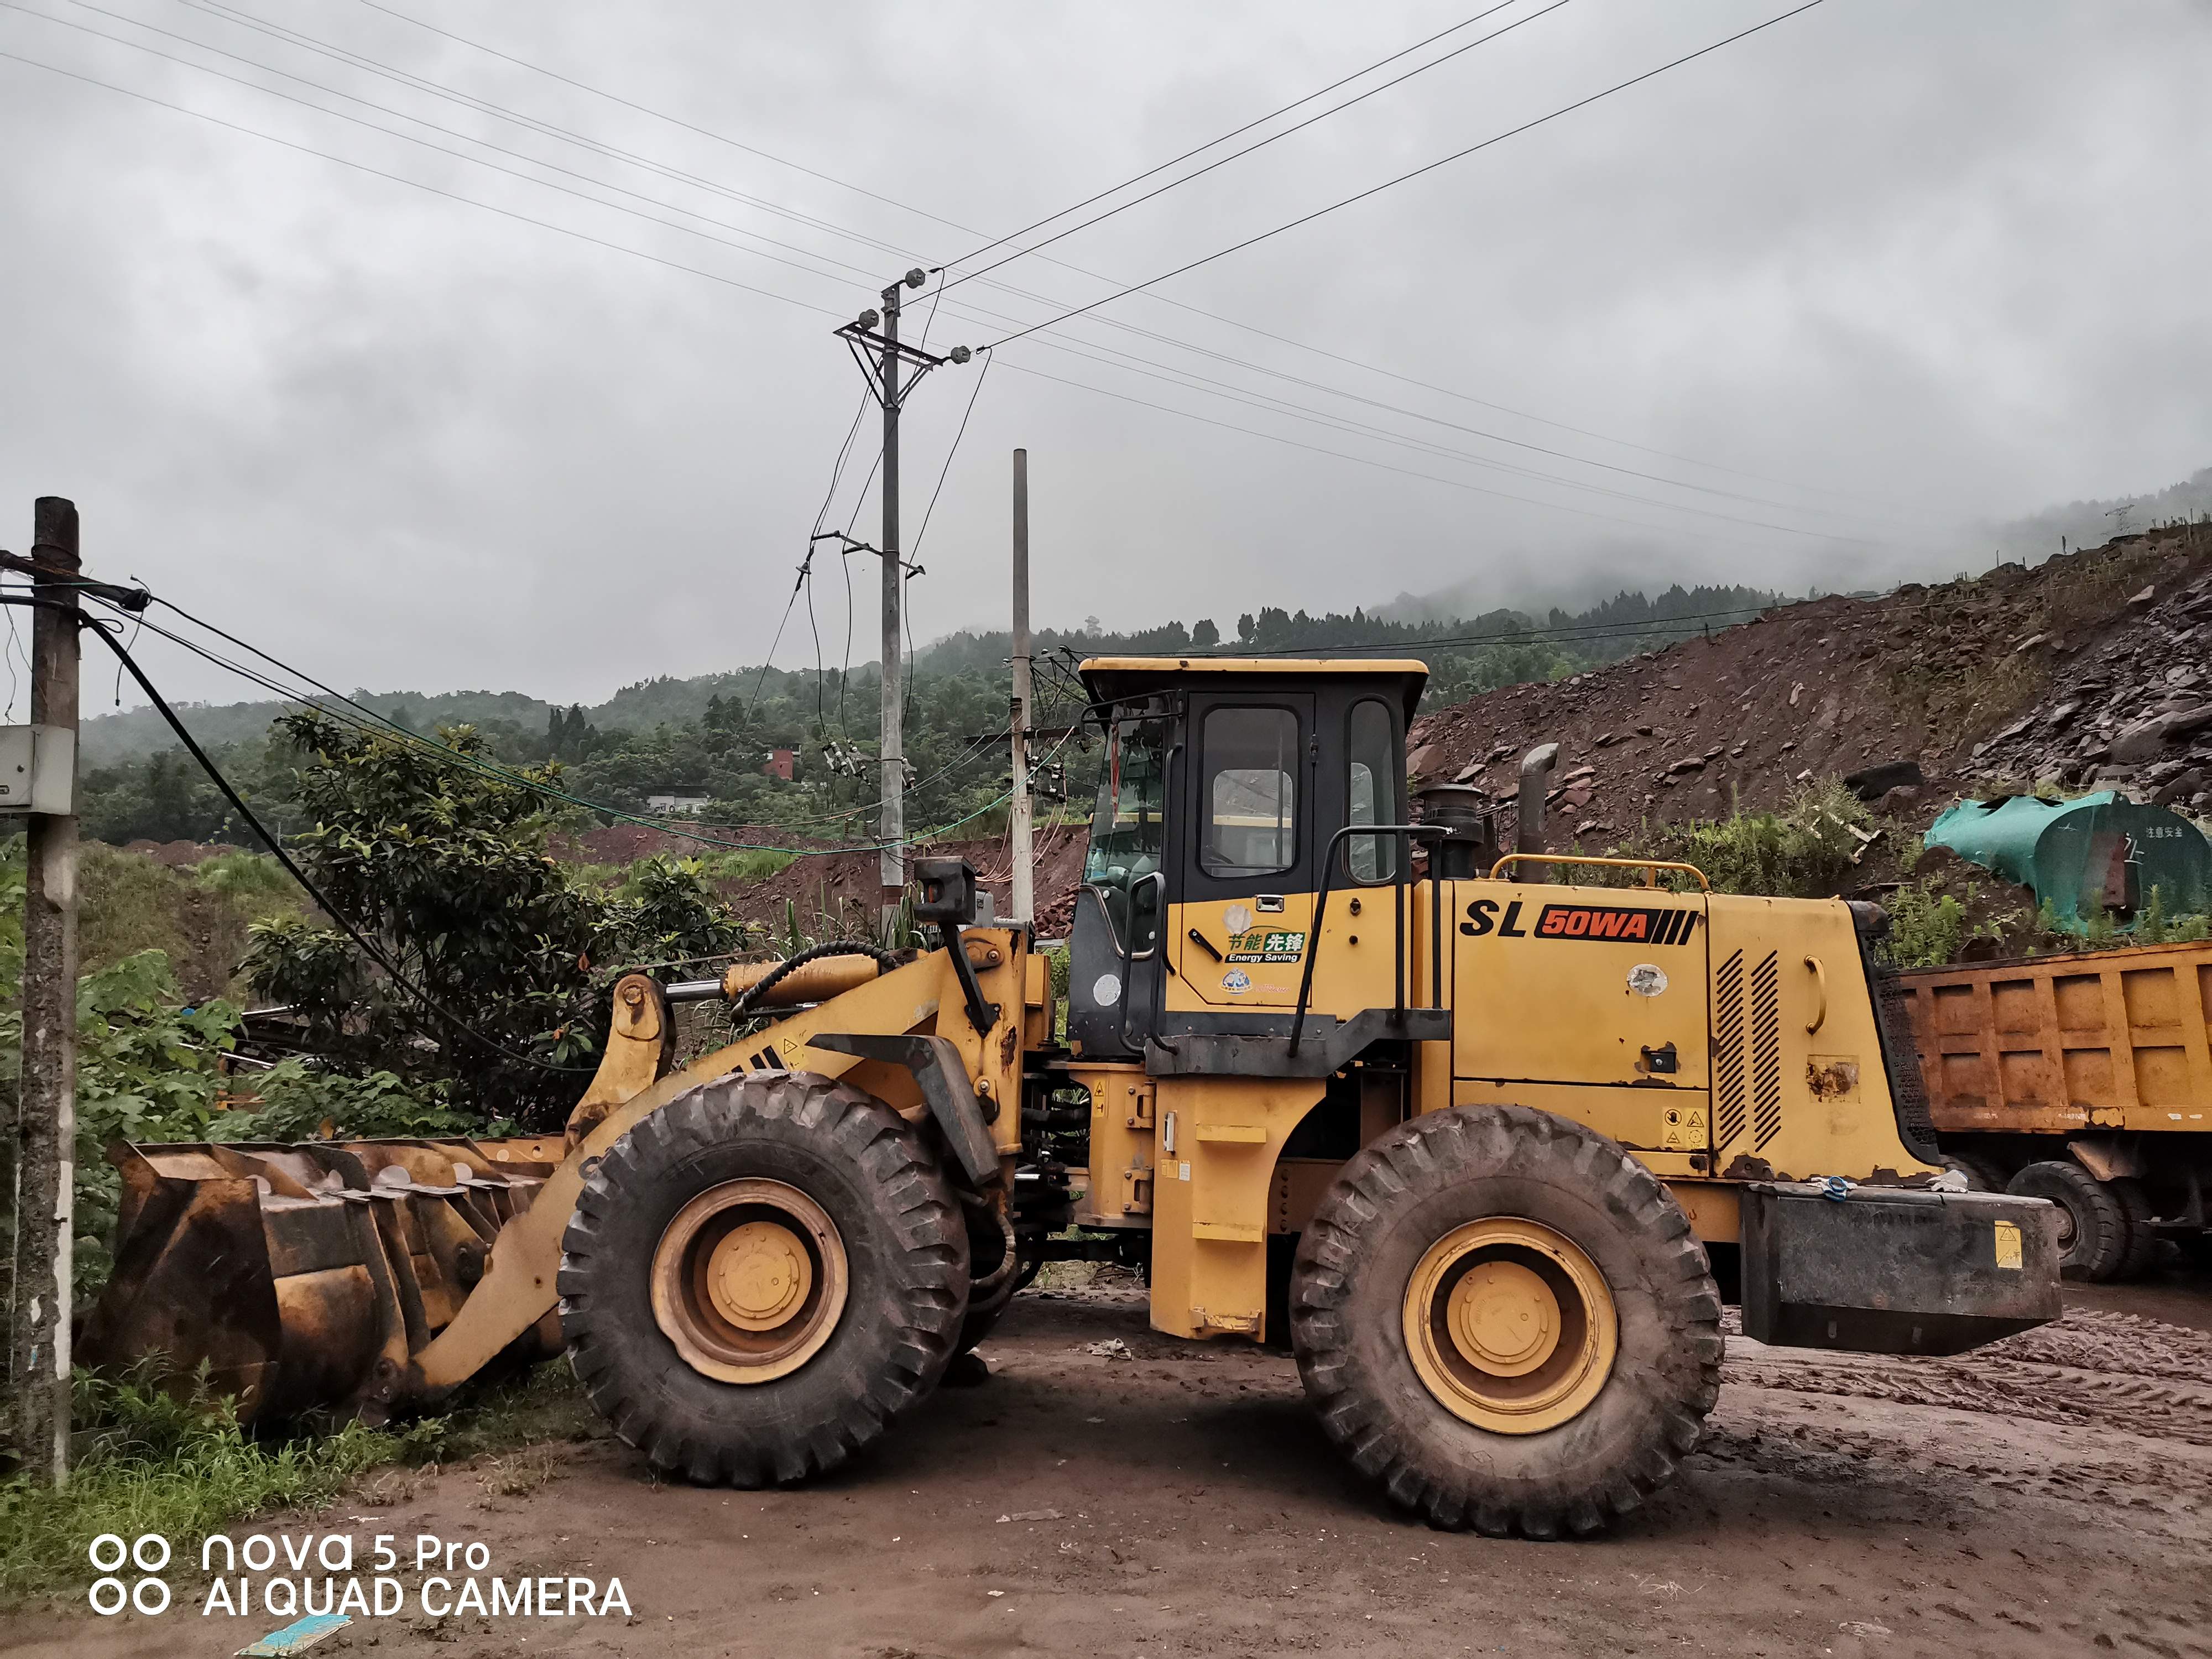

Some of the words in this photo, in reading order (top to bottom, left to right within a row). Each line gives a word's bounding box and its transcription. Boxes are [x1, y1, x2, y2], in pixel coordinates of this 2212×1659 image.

[2146, 826, 2183, 838] 注意安全
[1459, 899, 1526, 938] SL
[1541, 909, 1648, 938] 50WA
[1228, 933, 1303, 952] 节能先锋
[1229, 954, 1263, 963] Energy
[1264, 954, 1298, 963] Saving
